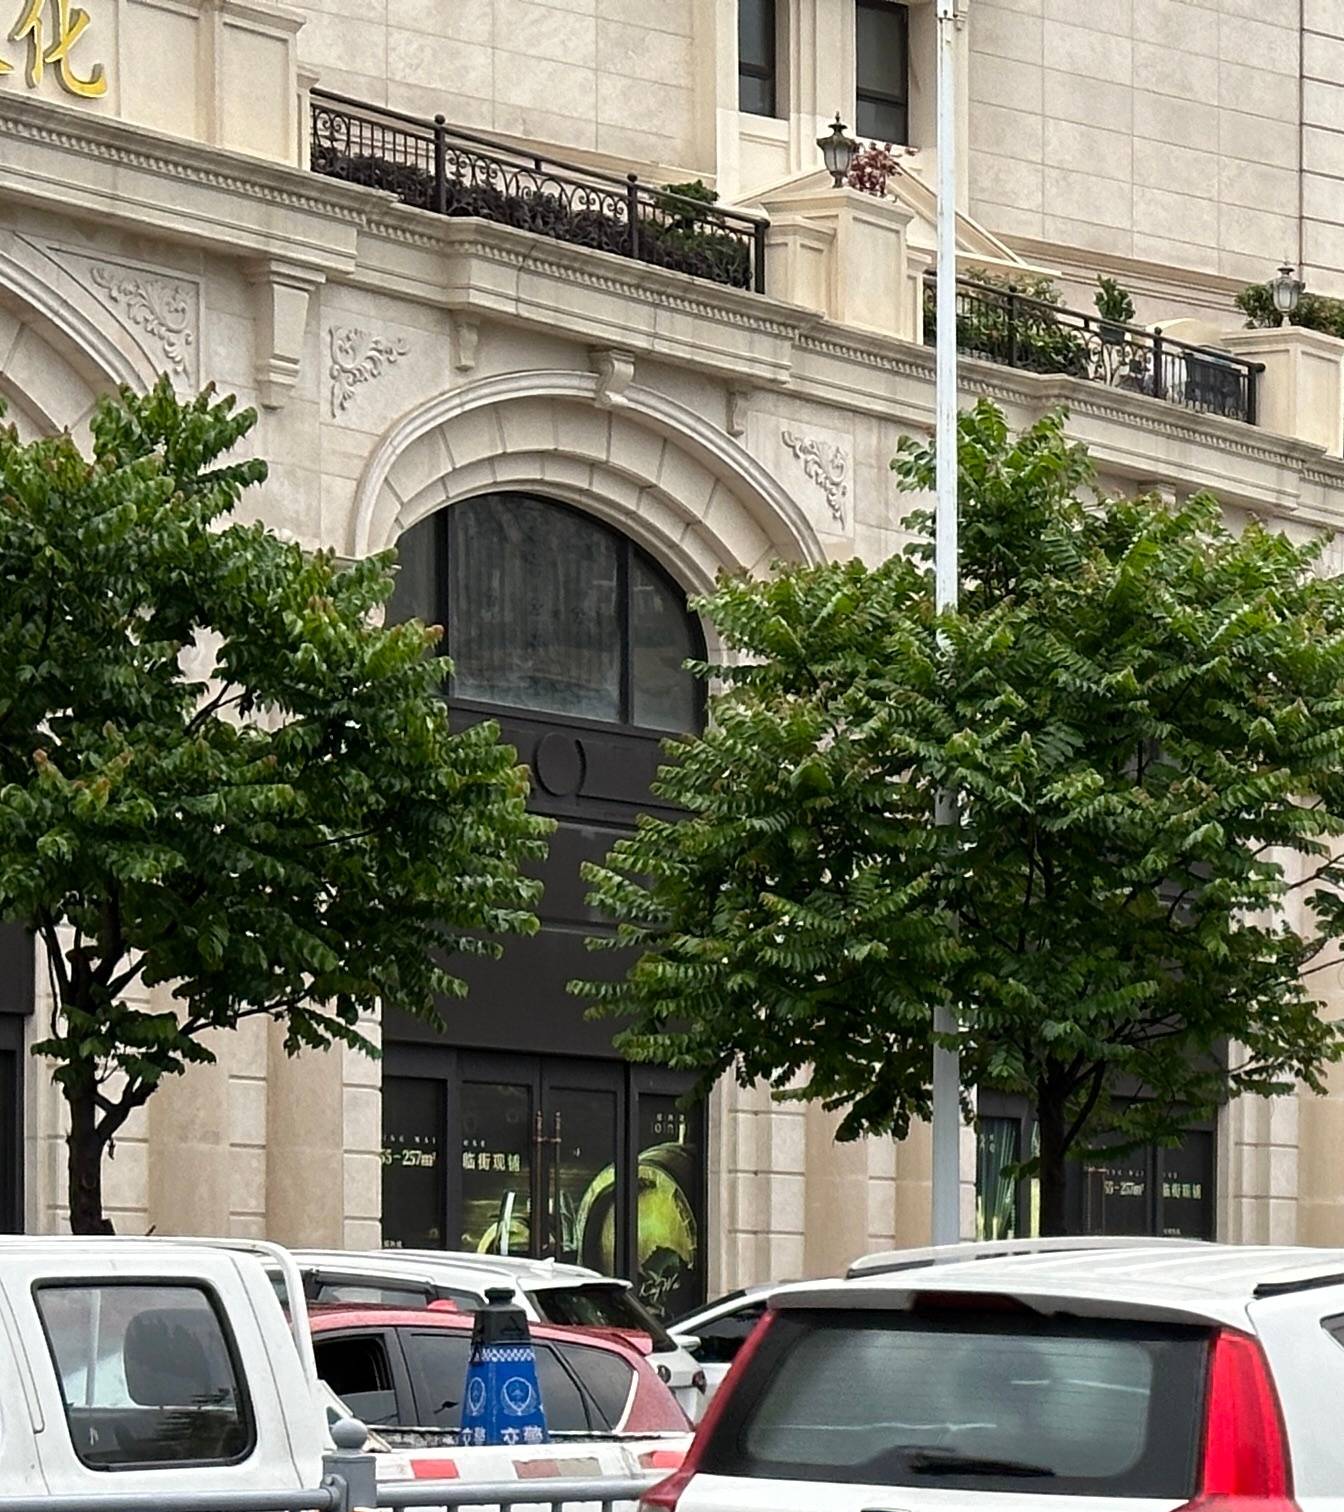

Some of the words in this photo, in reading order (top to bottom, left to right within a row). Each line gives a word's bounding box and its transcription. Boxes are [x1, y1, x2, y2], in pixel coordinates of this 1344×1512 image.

[0, 0, 107, 98] 化
[462, 1152, 520, 1171] 临街现铺
